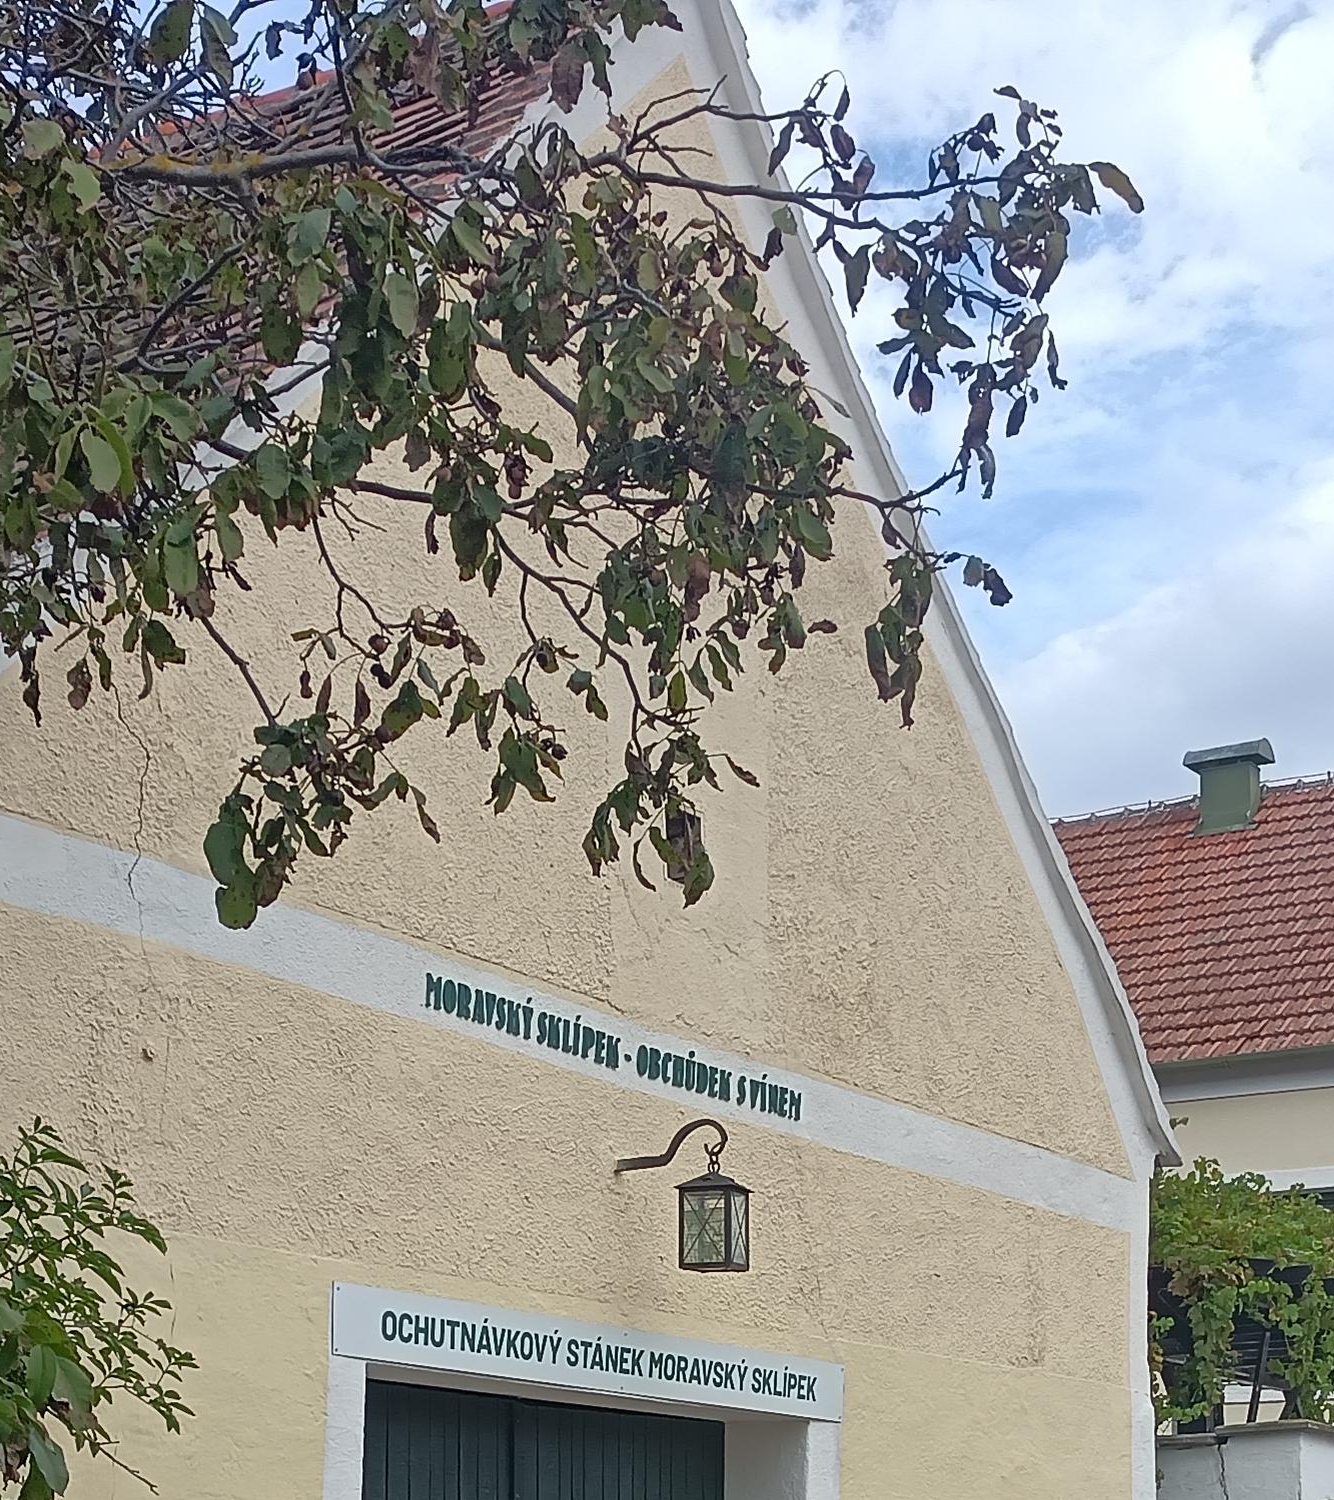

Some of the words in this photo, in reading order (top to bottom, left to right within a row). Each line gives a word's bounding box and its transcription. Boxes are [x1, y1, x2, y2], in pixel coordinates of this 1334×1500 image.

[425, 972, 534, 1040] MORAVSKÝ
[536, 1011, 621, 1070] SKLÍPEK
[636, 1044, 732, 1101] OBCHŮDEK
[736, 1075, 747, 1106] S
[750, 1073, 802, 1121] VÍNEM
[381, 1310, 563, 1365] OCHUTNÁVKOVÝ
[566, 1336, 644, 1377] STÁNEK
[648, 1351, 748, 1391] MORAVSKÝ
[751, 1365, 817, 1402] SKLÍPEK
